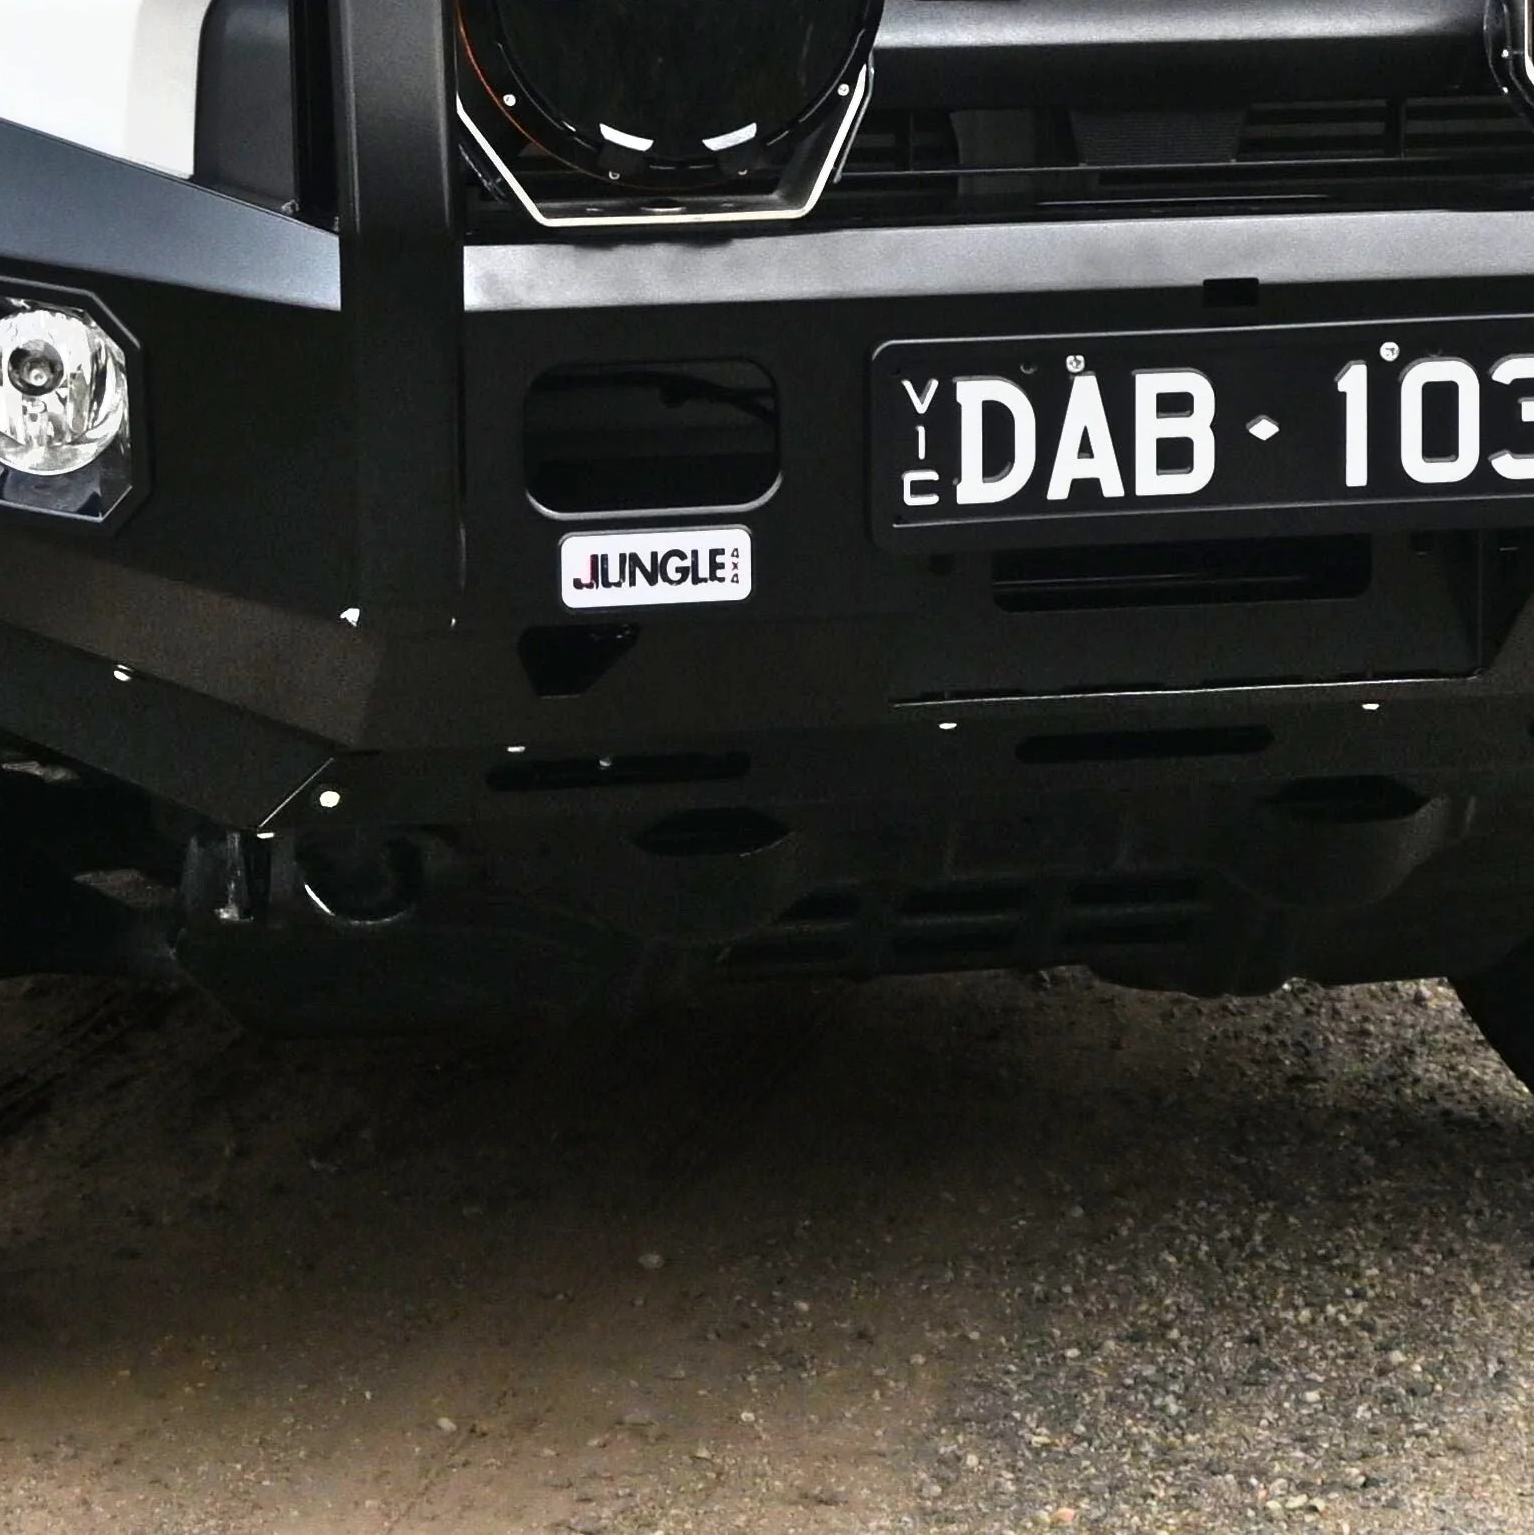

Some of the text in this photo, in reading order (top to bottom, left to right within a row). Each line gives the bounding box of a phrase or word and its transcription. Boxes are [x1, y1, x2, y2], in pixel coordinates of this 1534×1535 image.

[901, 378, 940, 506] VIC
[953, 368, 1216, 505] DAB
[572, 547, 726, 591] JUNGLE
